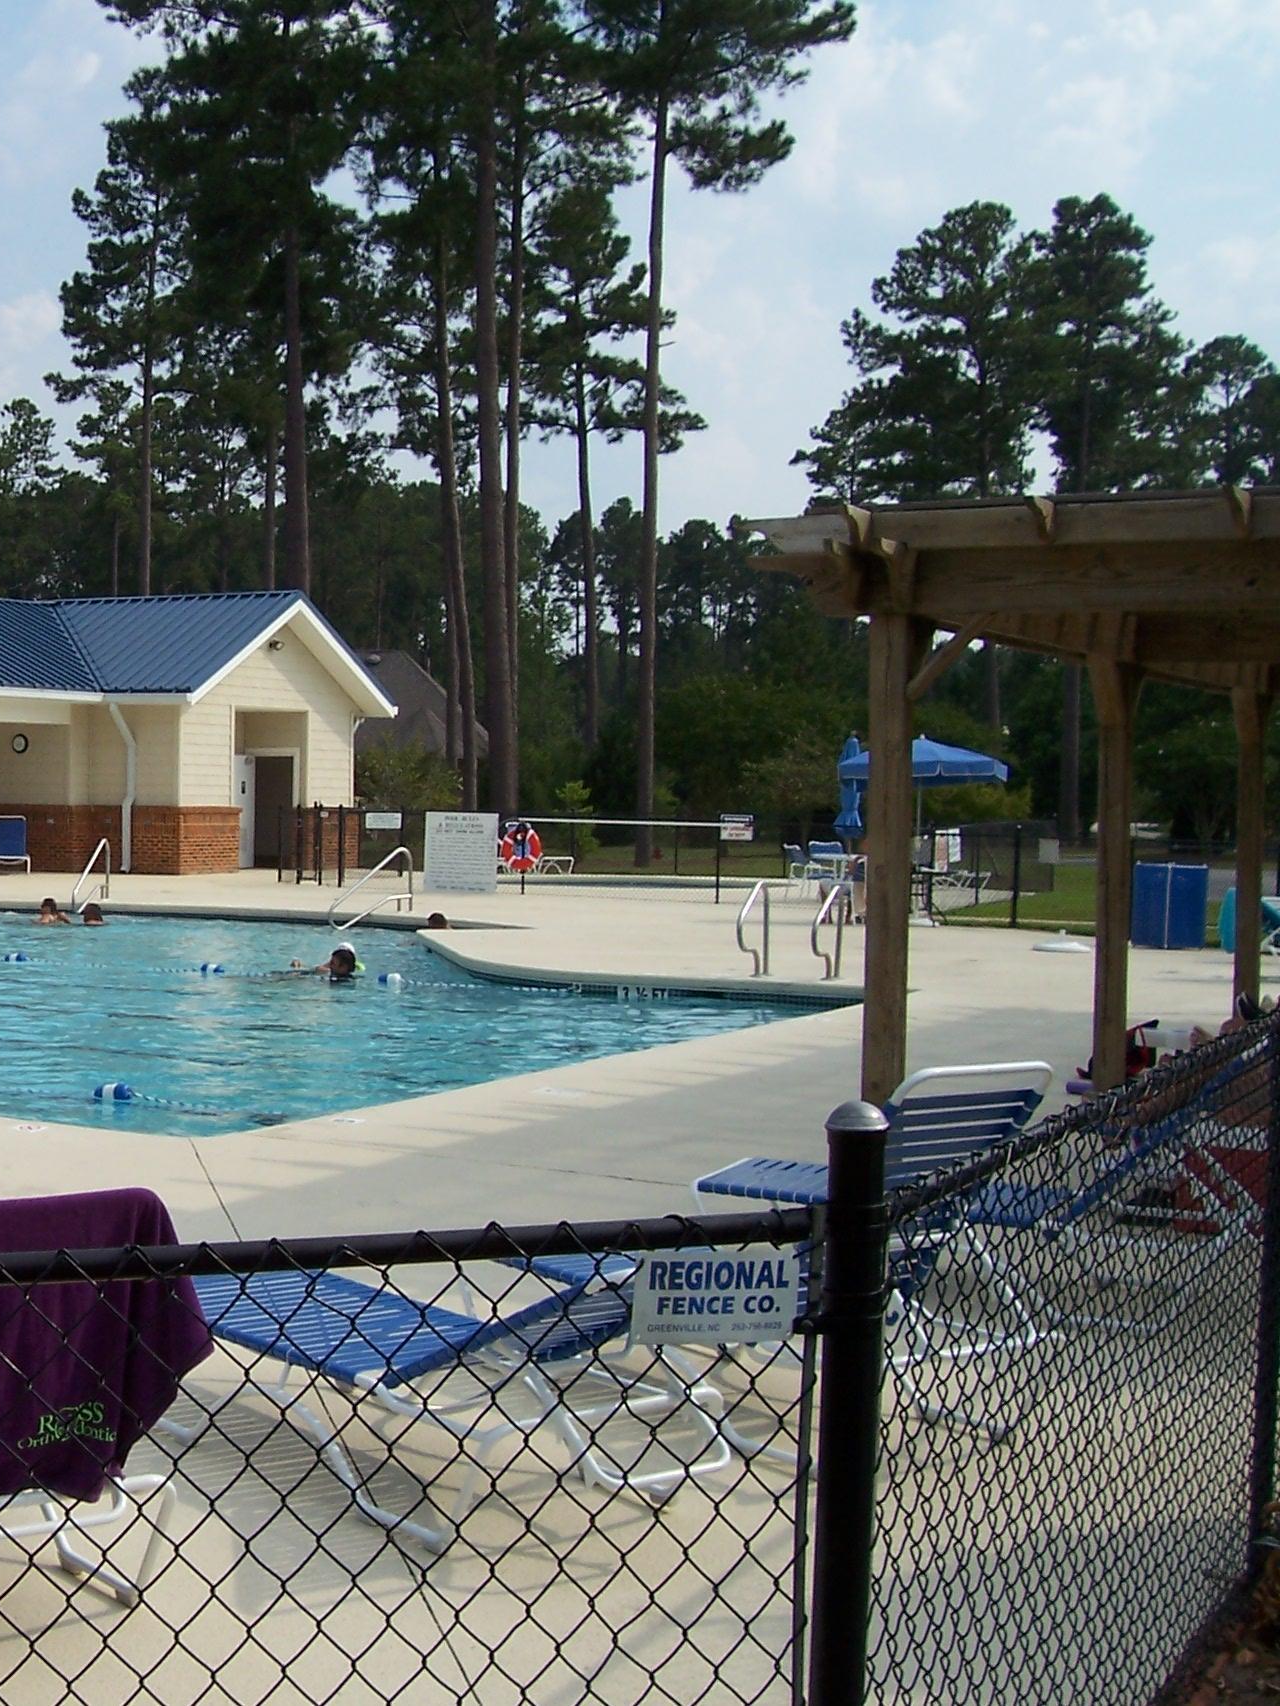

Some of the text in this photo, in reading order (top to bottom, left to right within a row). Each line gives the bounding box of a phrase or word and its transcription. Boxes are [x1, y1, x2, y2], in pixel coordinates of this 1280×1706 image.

[649, 1260, 789, 1290] REGIONAL
[656, 1295, 780, 1315] FENCE CO.
[708, 1323, 720, 1332] NC
